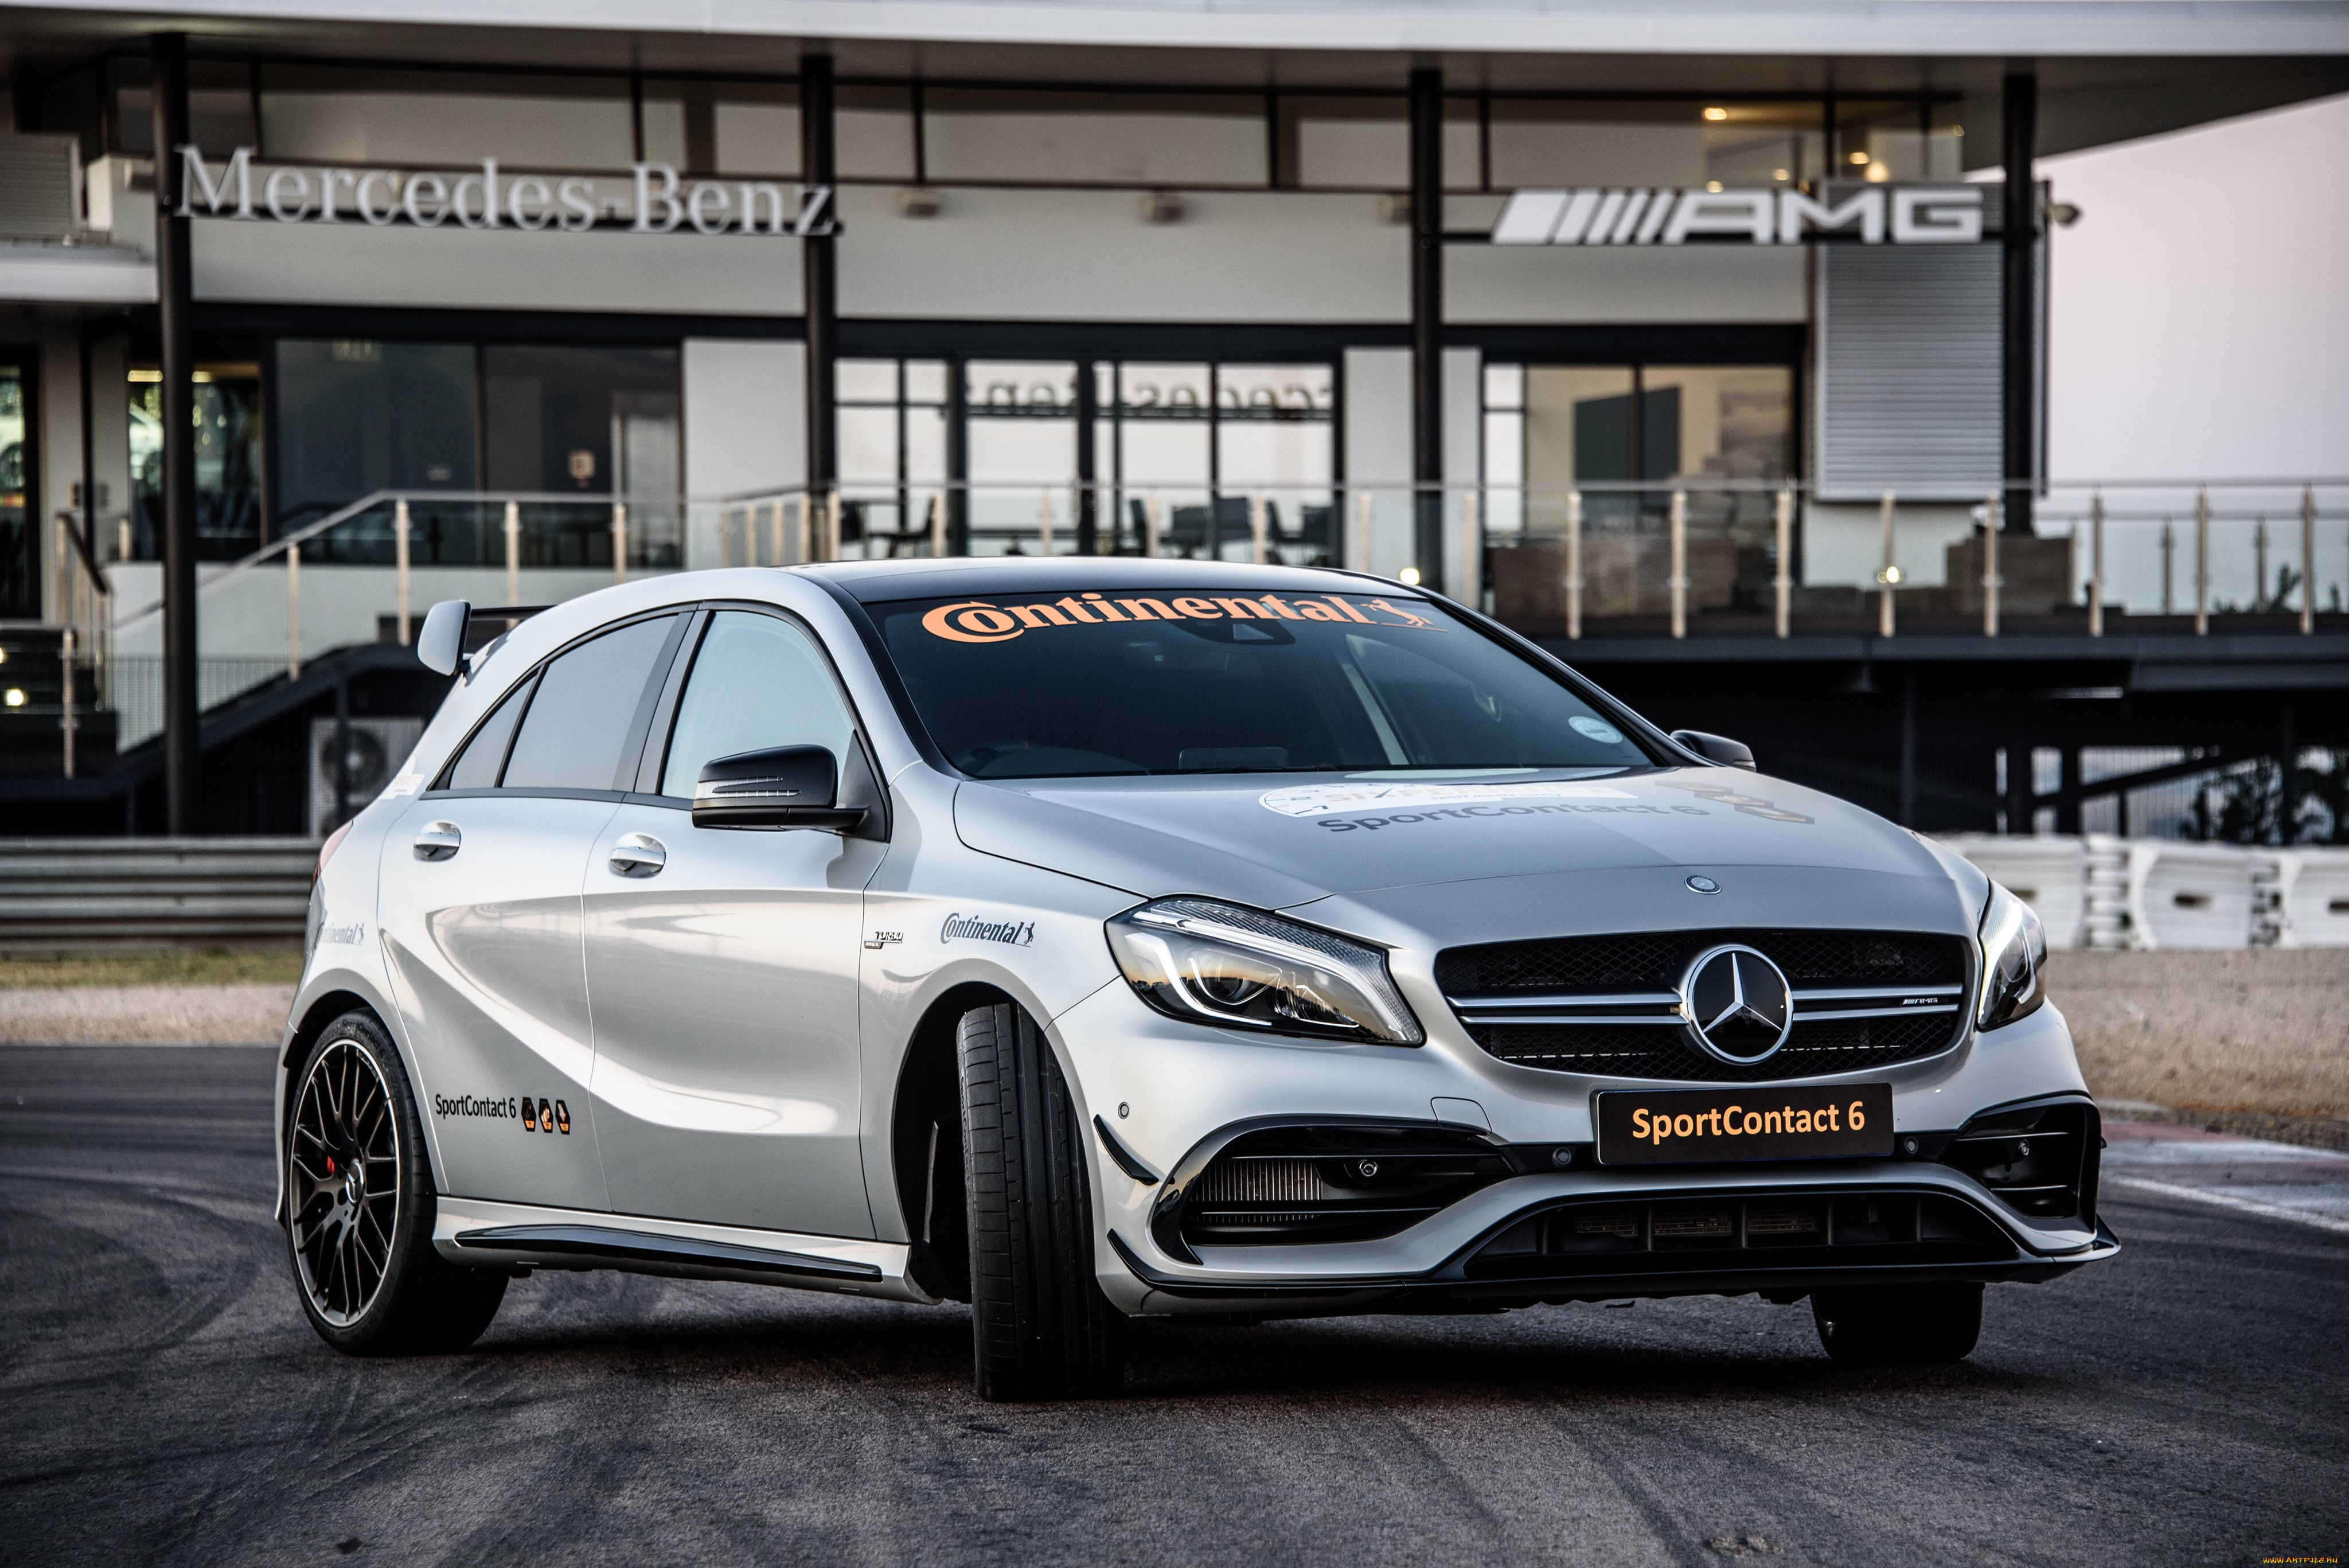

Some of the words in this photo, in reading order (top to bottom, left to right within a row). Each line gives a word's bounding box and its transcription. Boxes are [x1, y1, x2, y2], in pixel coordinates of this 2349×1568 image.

[173, 144, 837, 236] Mercedes-Benz
[922, 592, 1376, 643] Continental
[1317, 803, 1671, 832] SportContact
[1669, 805, 1711, 815] 6
[875, 931, 903, 941] TURBO
[941, 912, 1024, 944] Continental
[435, 1094, 508, 1119] SportContact
[509, 1097, 516, 1118] 6
[1633, 1104, 1839, 1145] SportContact
[1848, 1101, 1865, 1130] 6
